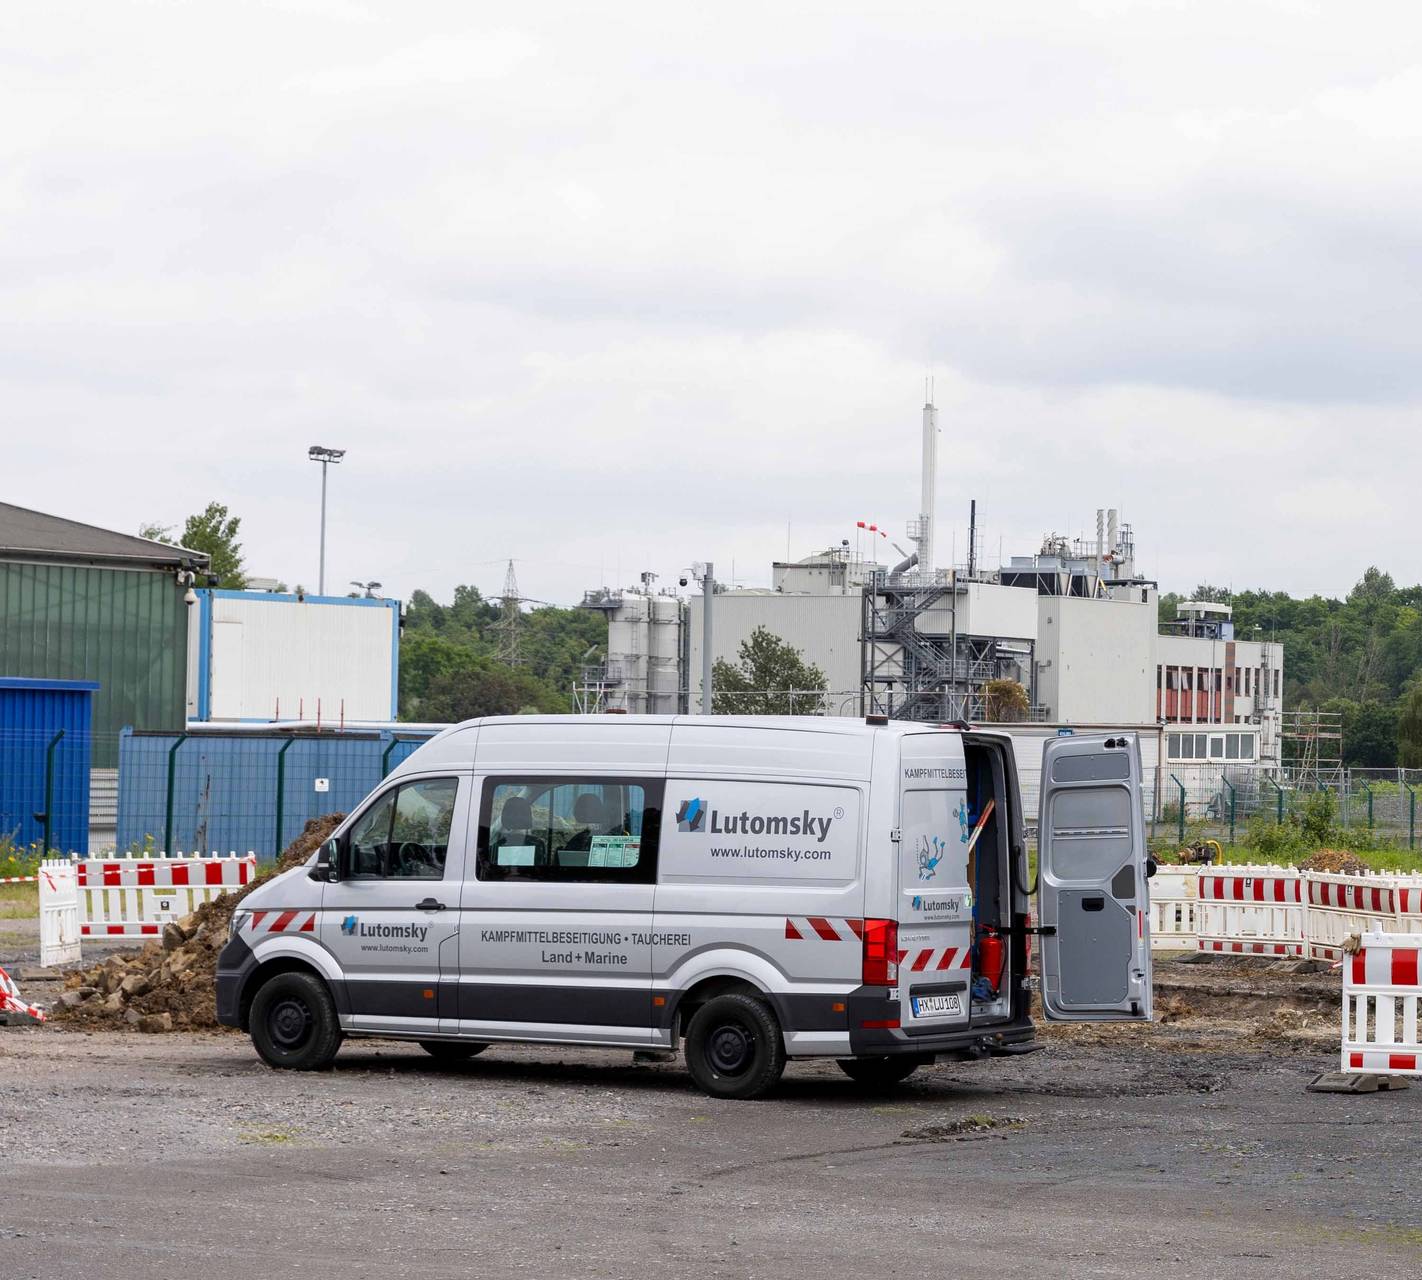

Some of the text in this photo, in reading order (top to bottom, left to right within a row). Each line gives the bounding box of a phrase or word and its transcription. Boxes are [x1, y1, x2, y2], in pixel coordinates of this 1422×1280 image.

[710, 846, 832, 862] www.lutomsky.com
[923, 898, 959, 912] Lutomsky
[360, 922, 428, 942] Lutomsky
[481, 930, 622, 945] KAMPFMITTELBESEITIGUNG
[631, 933, 691, 946] TAUCHEREI
[360, 943, 429, 954] www.lutomsky.com
[541, 950, 573, 964] Land
[584, 951, 628, 965] Marine
